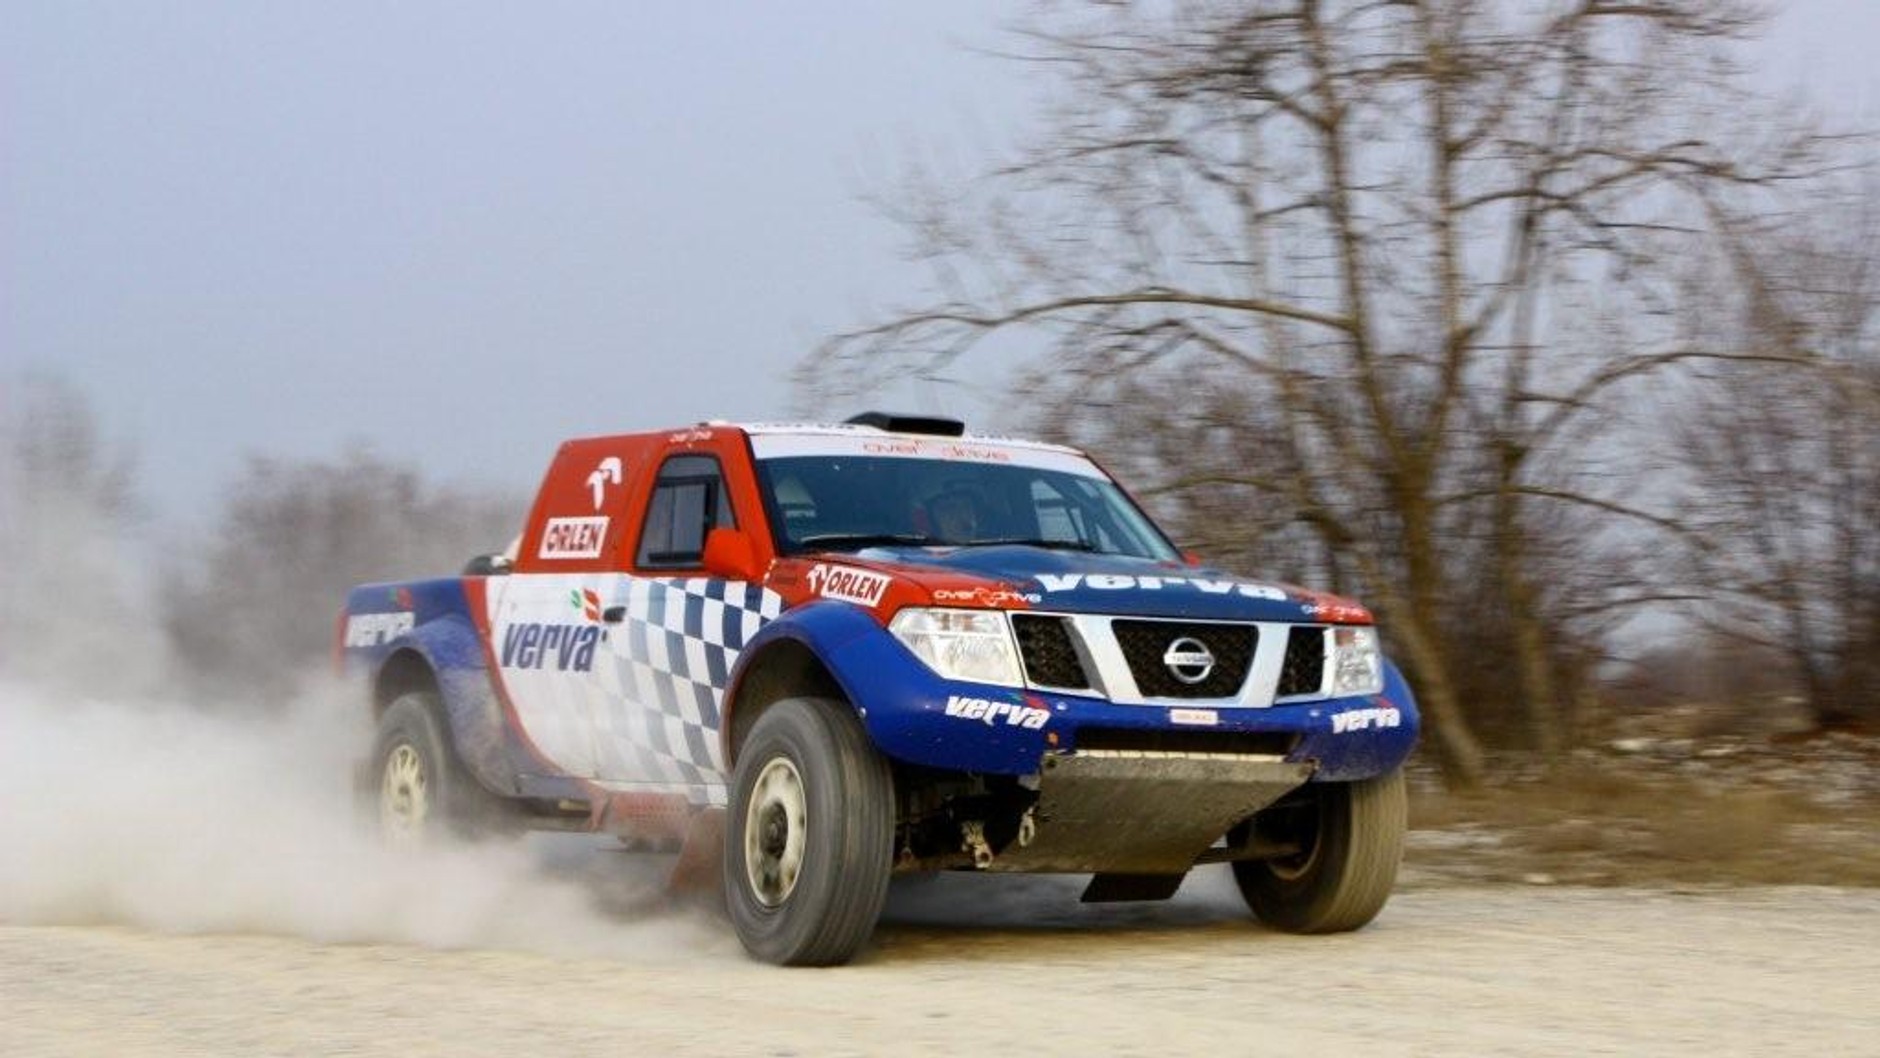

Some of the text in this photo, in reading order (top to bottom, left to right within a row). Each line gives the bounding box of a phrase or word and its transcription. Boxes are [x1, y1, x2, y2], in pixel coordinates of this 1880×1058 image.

[546, 524, 603, 552] ORLEN
[827, 571, 884, 601] ORLEN
[1033, 573, 1288, 601] verva
[502, 623, 599, 672] verva
[945, 696, 1051, 730] verva
[1331, 707, 1400, 734] verva
